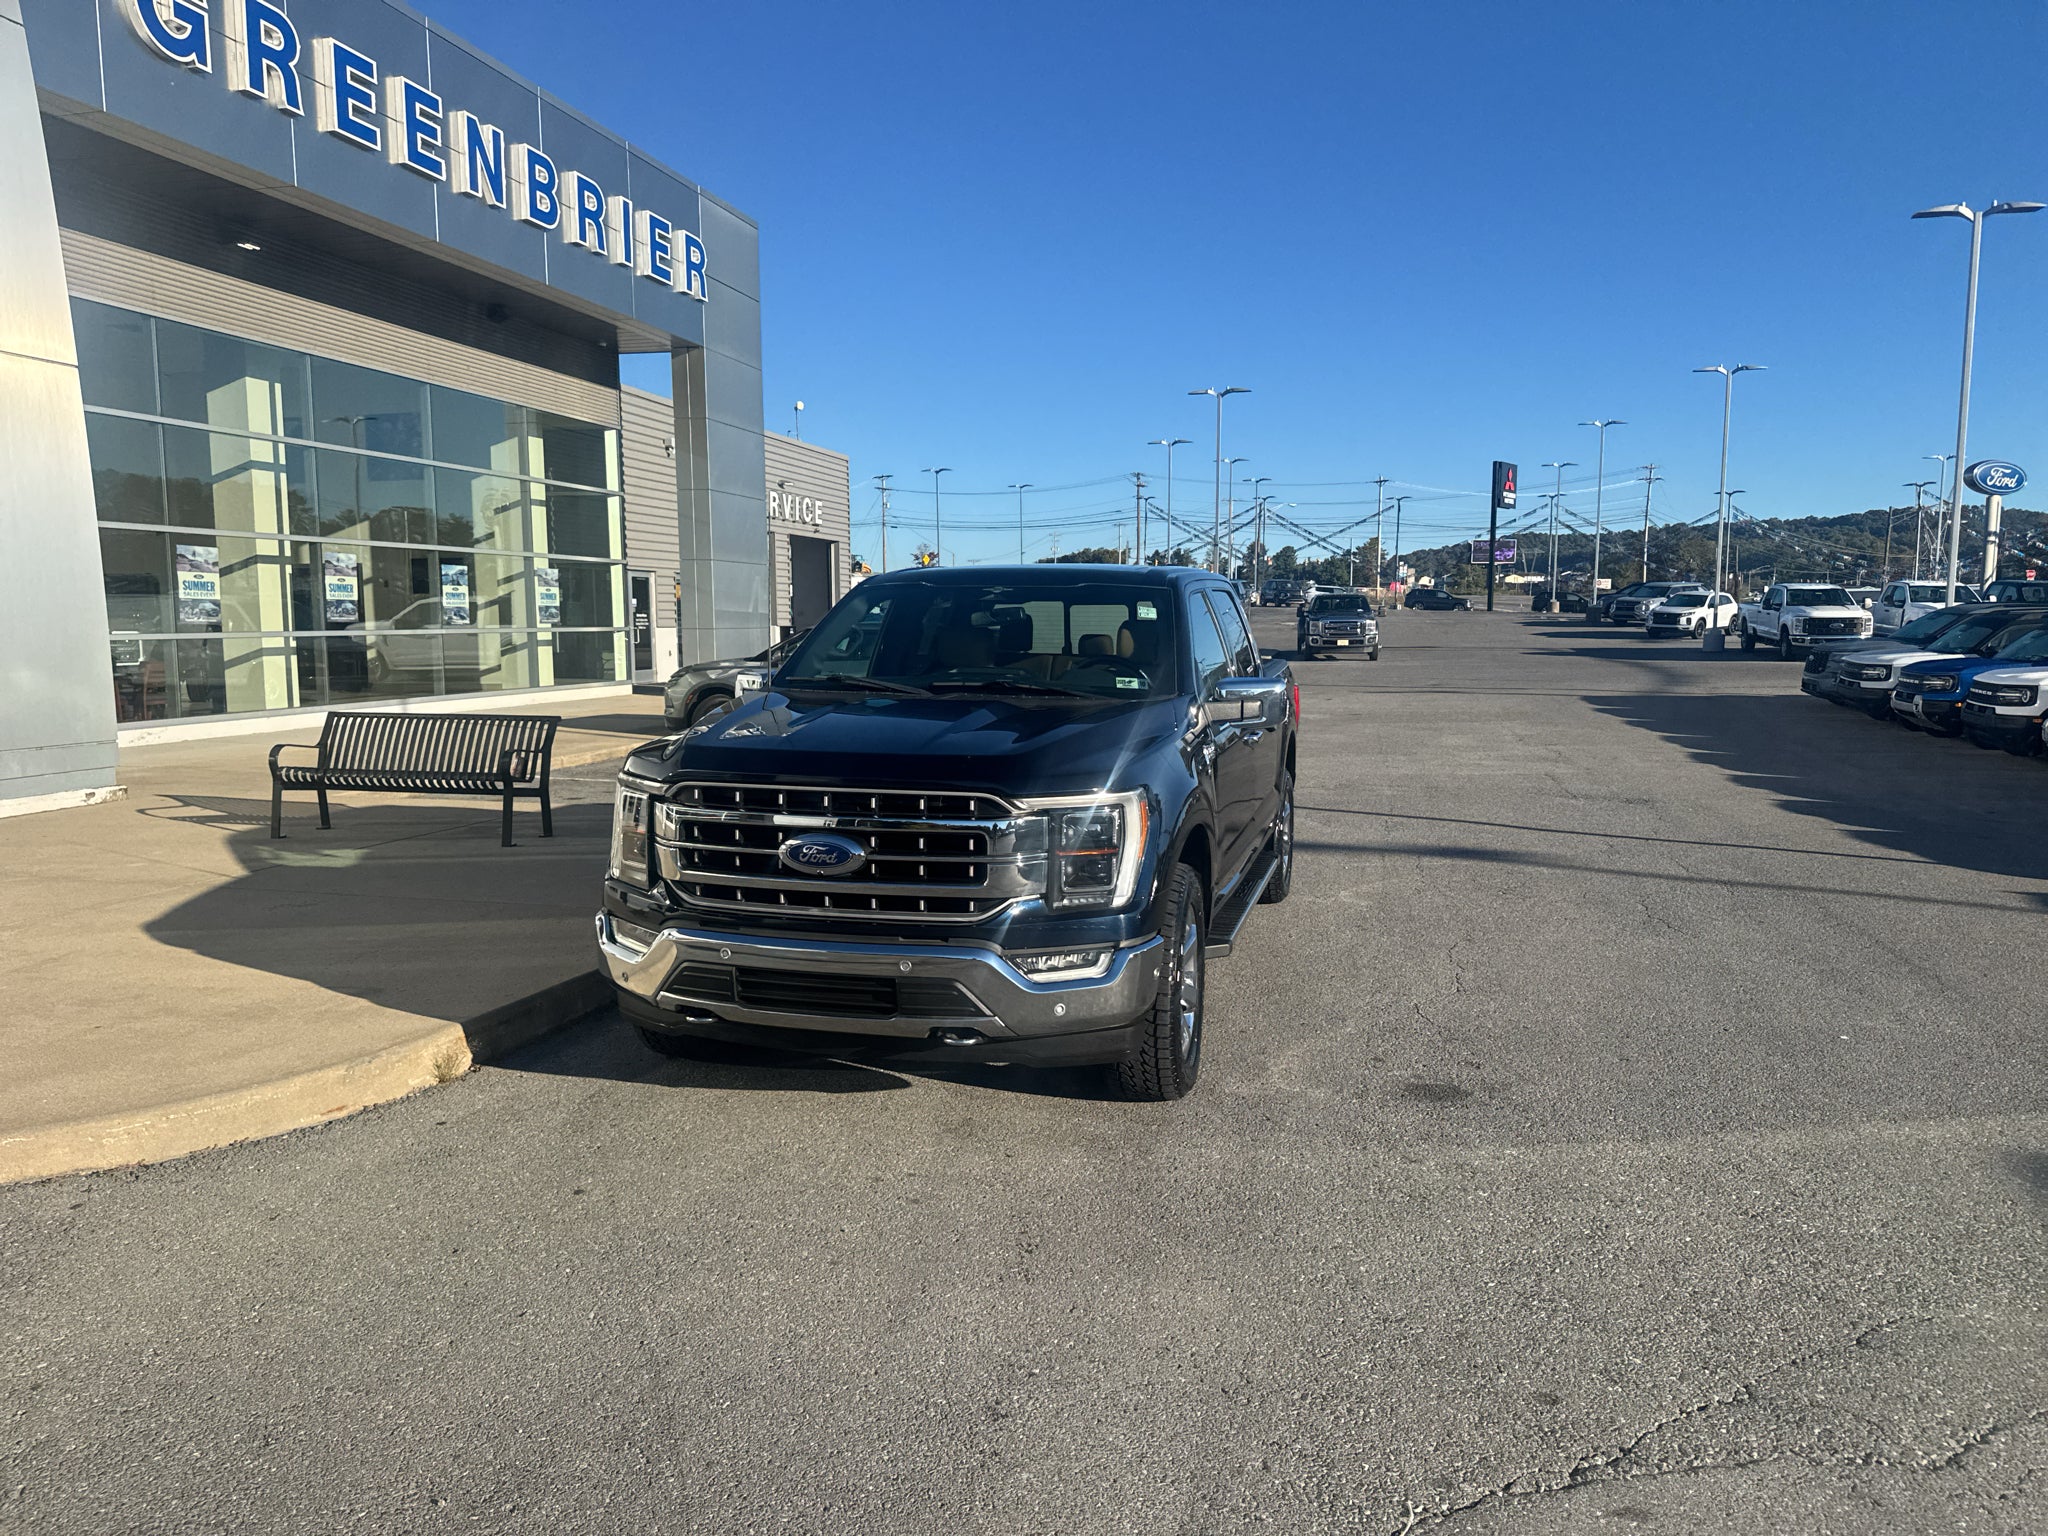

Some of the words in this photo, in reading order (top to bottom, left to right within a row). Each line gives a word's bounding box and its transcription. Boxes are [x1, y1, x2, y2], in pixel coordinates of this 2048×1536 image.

[1986, 467, 2019, 488] Ford
[769, 490, 823, 525] RVICE
[182, 580, 216, 592] SUMMER
[328, 583, 354, 593] SUMMER
[799, 844, 839, 864] Ford
